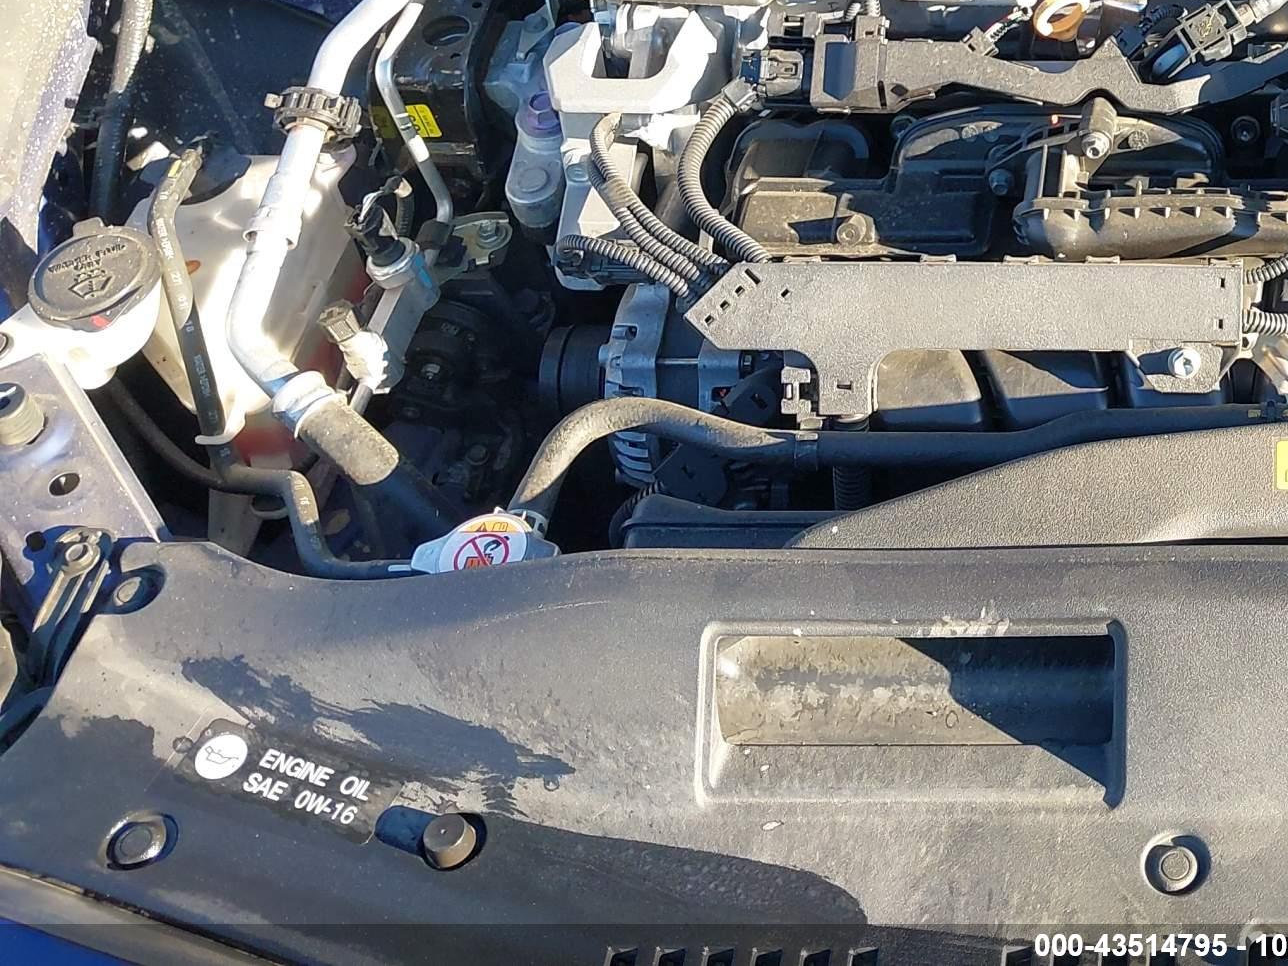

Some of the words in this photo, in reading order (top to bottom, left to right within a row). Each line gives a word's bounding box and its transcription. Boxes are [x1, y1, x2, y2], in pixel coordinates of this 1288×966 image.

[242, 773, 288, 801] SAE
[294, 790, 359, 825] 0W-16
[259, 748, 335, 787] ENGINE
[340, 776, 371, 801] OIL
